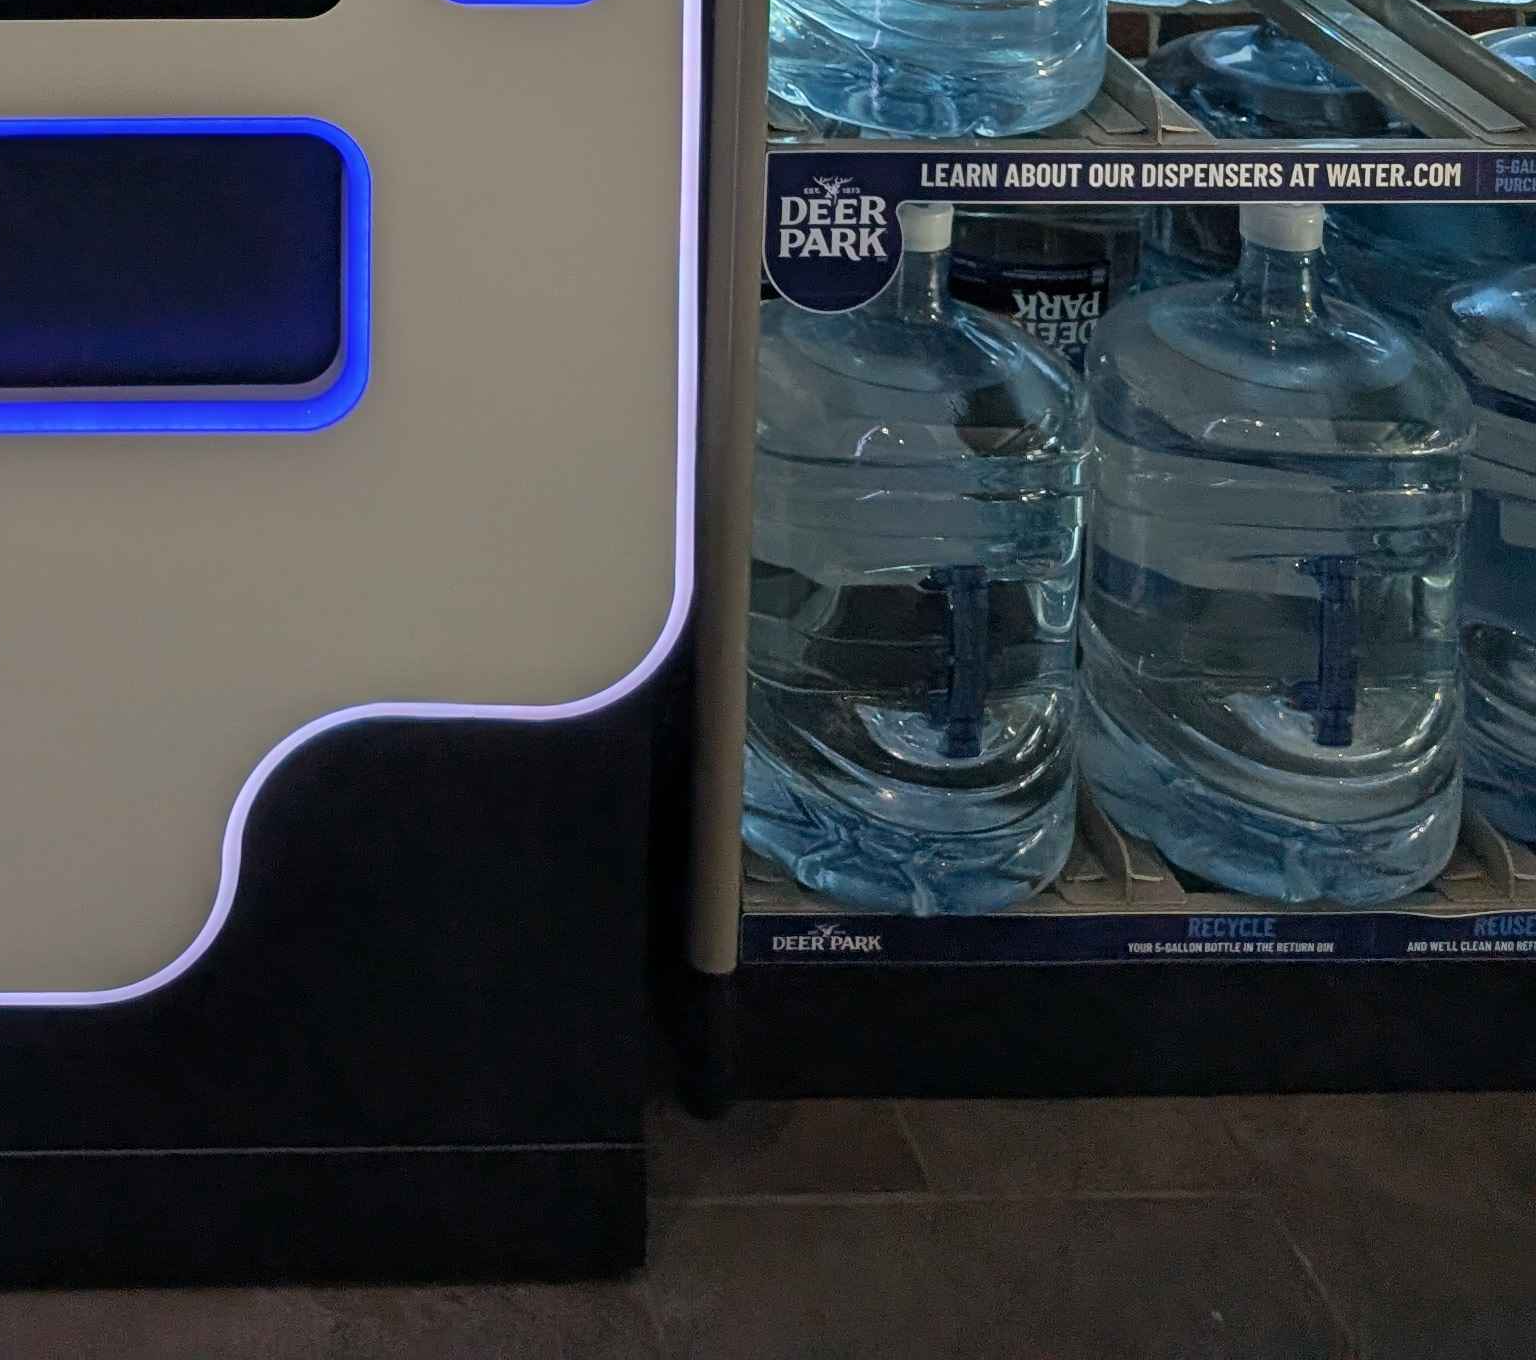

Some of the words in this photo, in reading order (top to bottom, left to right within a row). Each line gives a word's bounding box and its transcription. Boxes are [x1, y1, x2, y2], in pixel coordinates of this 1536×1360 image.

[921, 163, 998, 188] LEARN
[1004, 163, 1083, 188] ABOUT
[1088, 163, 1135, 188] OUR
[1141, 162, 1284, 188] DISPENSERS
[1289, 163, 1320, 188] AT
[1326, 162, 1462, 188] WATER.COM
[779, 195, 887, 225] DEER
[778, 228, 887, 261] PARK
